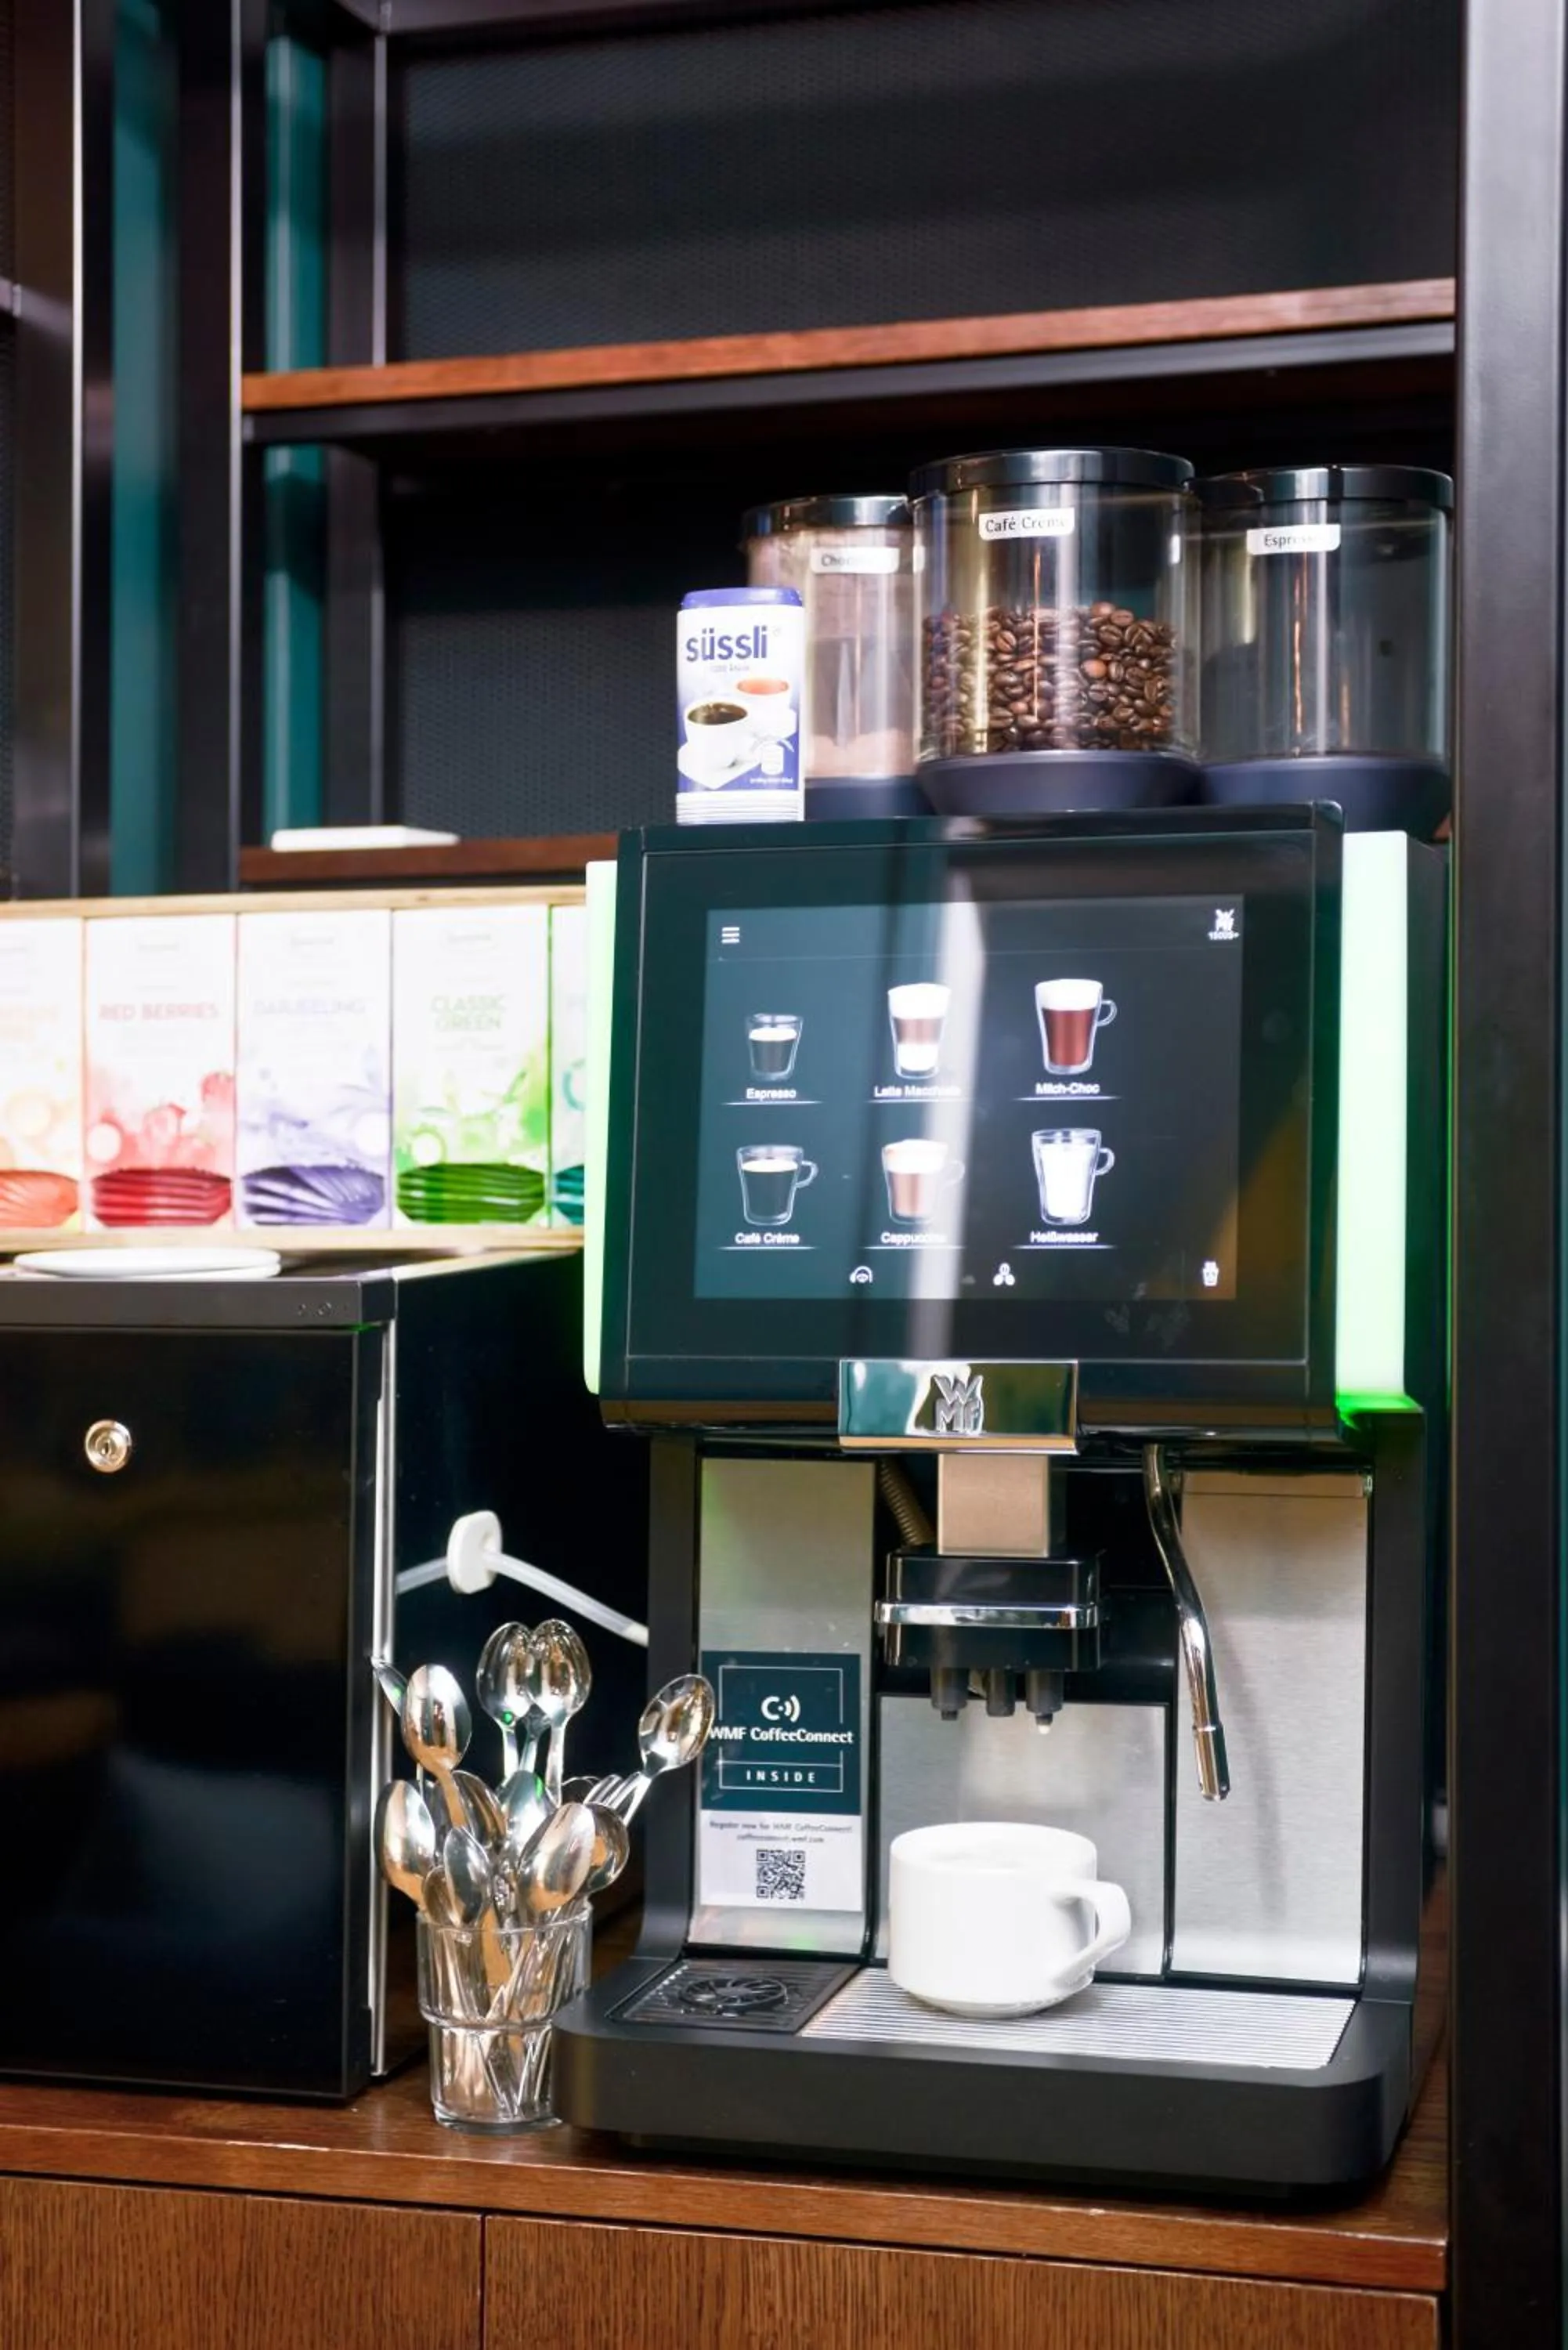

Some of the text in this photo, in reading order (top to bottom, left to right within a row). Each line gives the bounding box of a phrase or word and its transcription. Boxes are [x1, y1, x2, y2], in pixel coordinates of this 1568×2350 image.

[985, 516, 1017, 532] Café
[685, 625, 768, 662] süssli
[99, 1001, 219, 1021] RED BERRIES
[746, 1087, 797, 1101] Espresso
[710, 1726, 853, 1744] WMF CoffeeConnect
[746, 1770, 816, 1784] INSIDE
